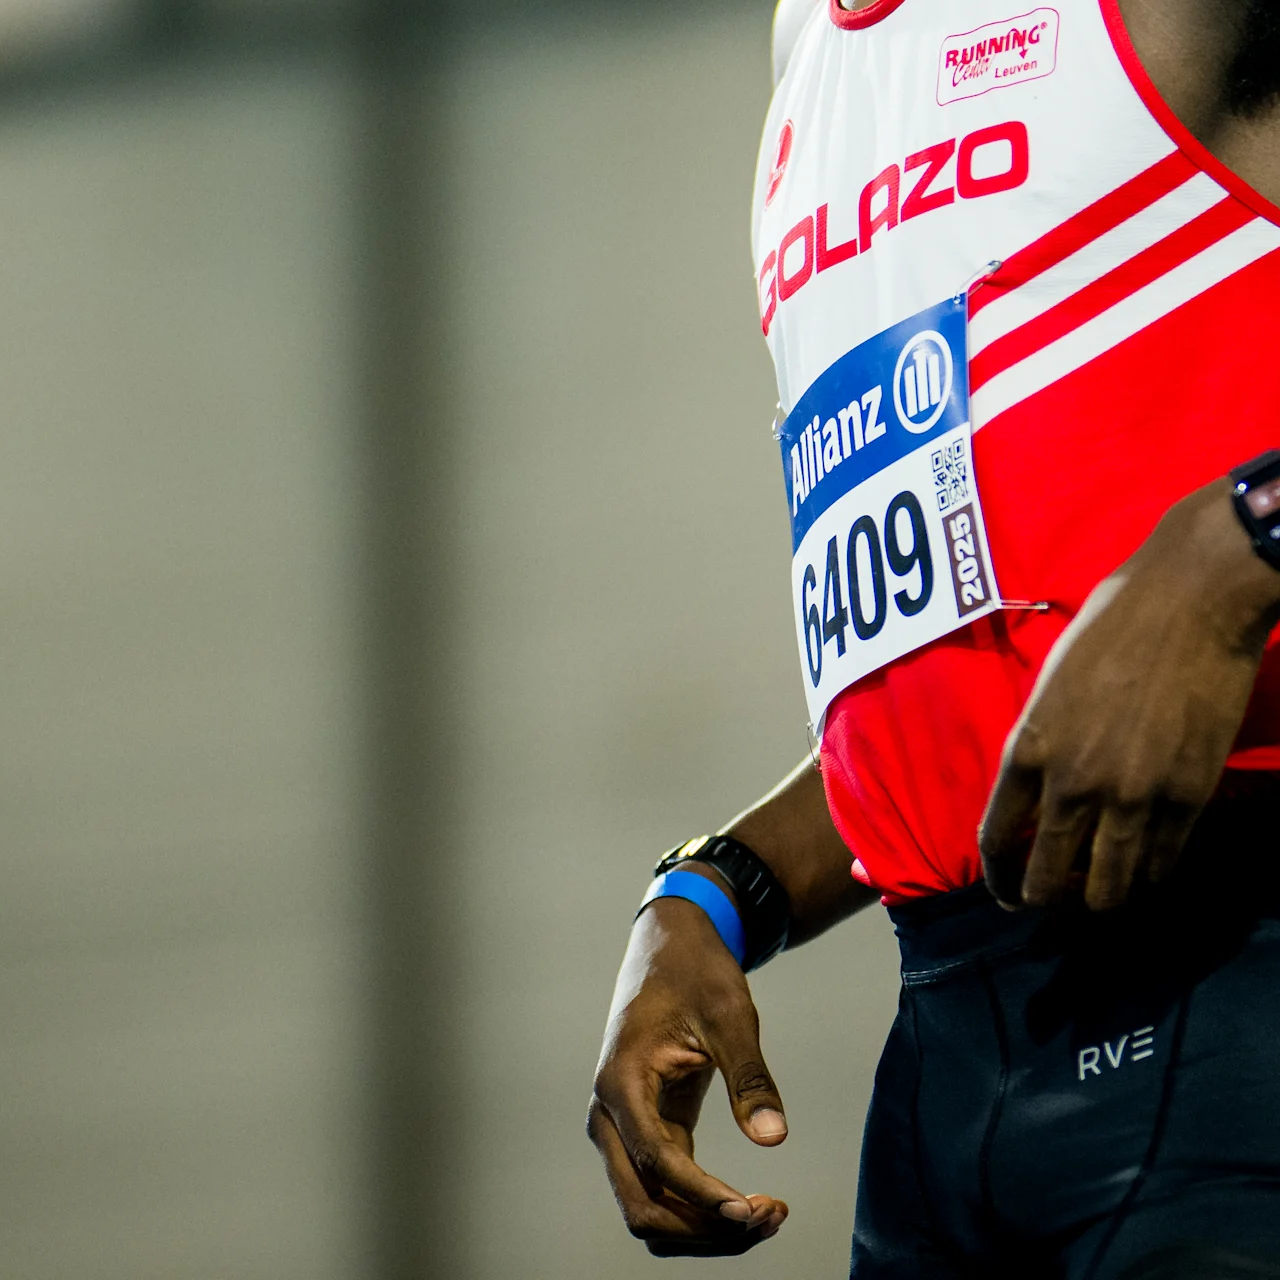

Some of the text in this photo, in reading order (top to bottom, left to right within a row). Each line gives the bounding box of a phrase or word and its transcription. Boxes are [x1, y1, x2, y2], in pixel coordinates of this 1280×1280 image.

[994, 60, 1038, 79] Leuven
[760, 120, 1030, 337] GOLAZO
[790, 384, 887, 518] Allianz
[801, 490, 935, 688] 6409
[949, 512, 985, 606] 2025
